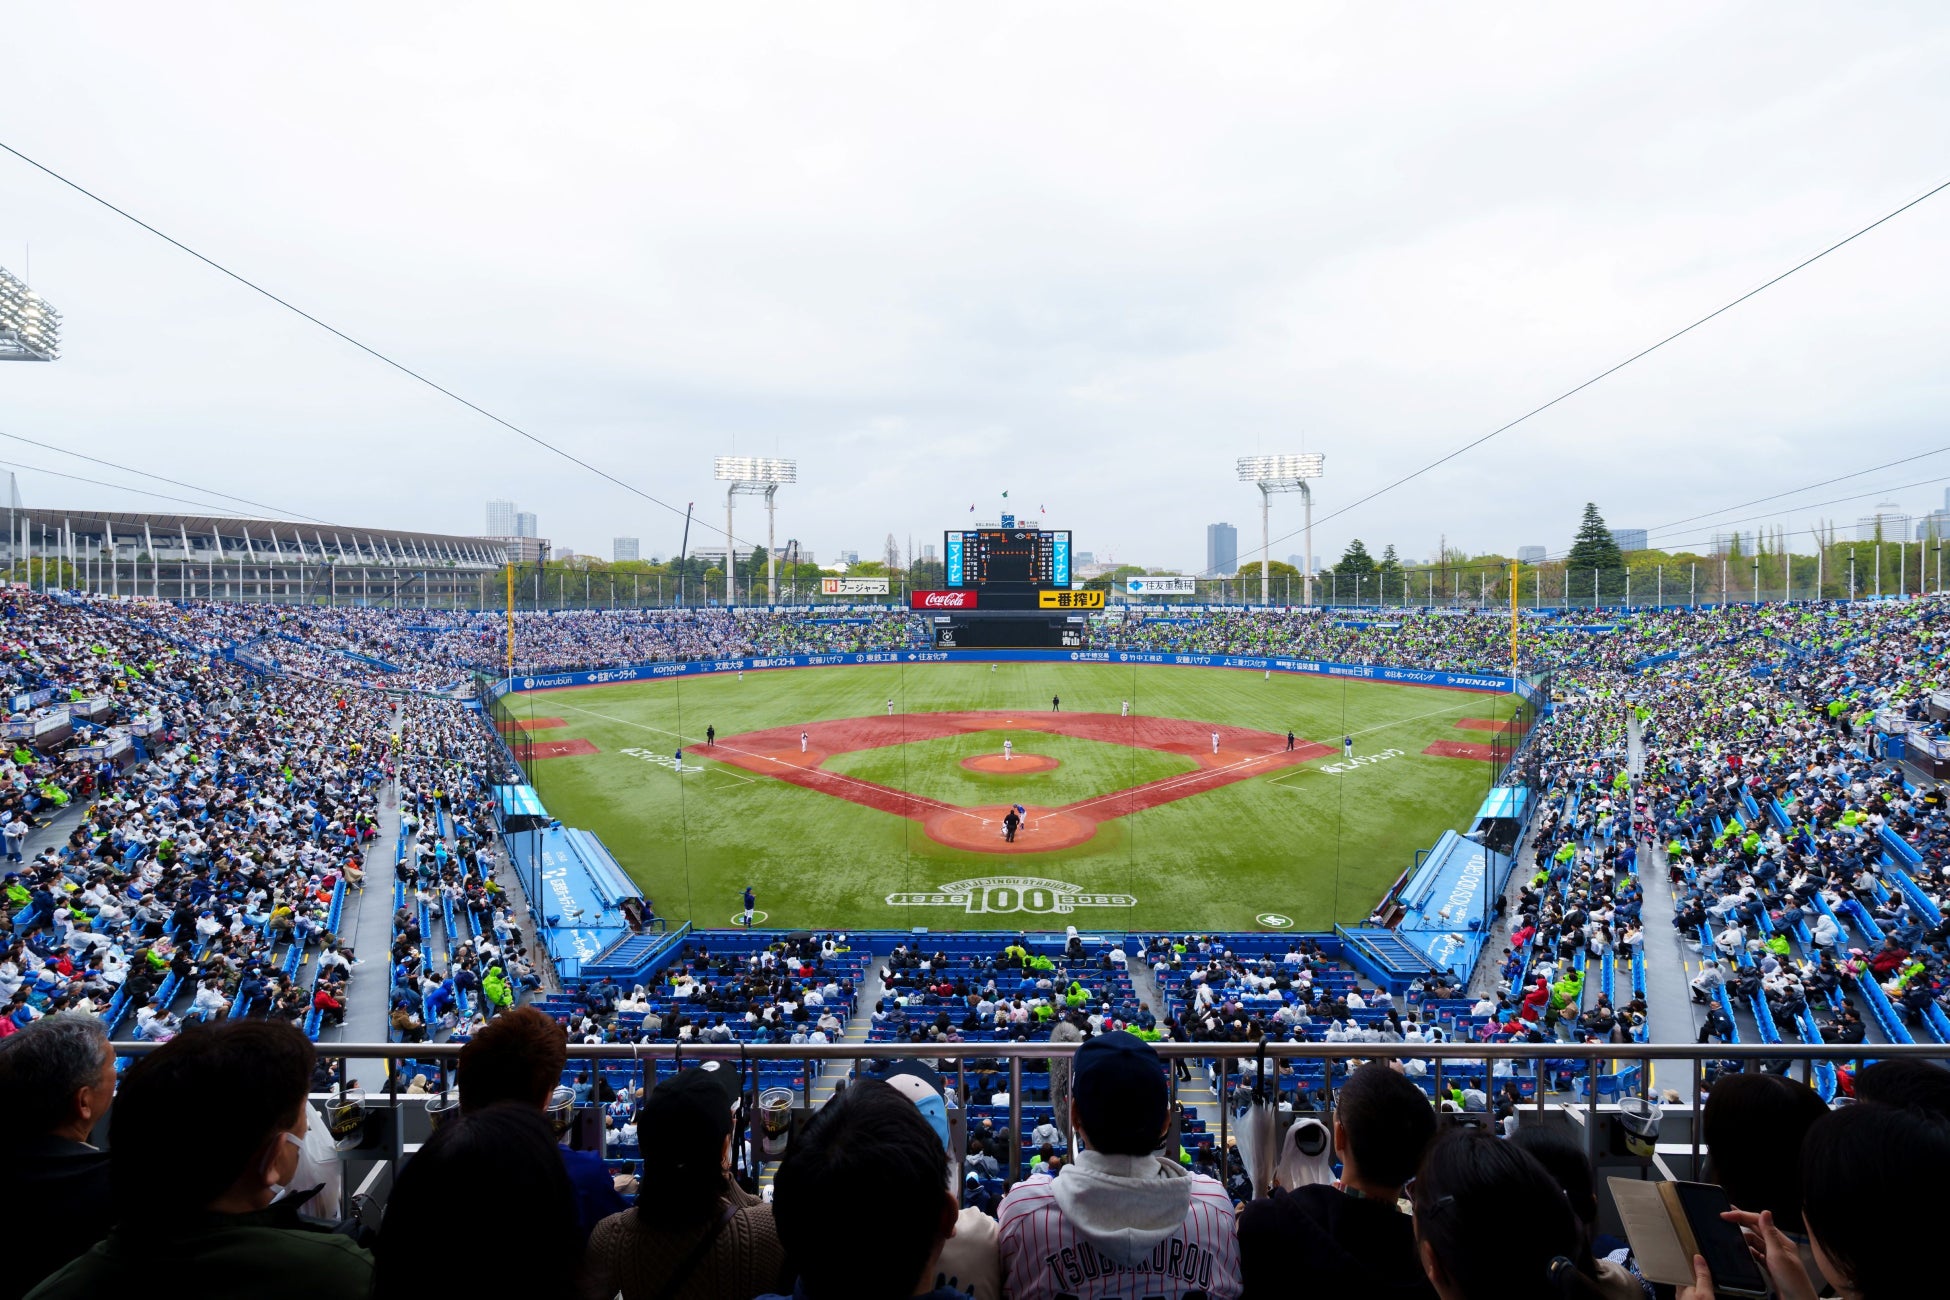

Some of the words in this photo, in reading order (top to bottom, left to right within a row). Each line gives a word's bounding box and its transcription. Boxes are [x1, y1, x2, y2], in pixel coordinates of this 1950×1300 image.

[950, 544, 960, 582] マイナビ
[1056, 544, 1066, 582] マイナビ
[840, 584, 886, 592] フージャース
[1146, 580, 1193, 590] 住友重機械
[926, 592, 966, 606] Coca-Cola
[1044, 592, 1100, 606] 一番搾り
[1062, 636, 1080, 646] 青山
[808, 656, 843, 664] 安藤ハザマ
[866, 654, 898, 662] 東鉄工業
[918, 653, 948, 661] 住友化学
[1176, 656, 1211, 665] 安藤ハザマ
[714, 661, 744, 671] 文教大学
[752, 658, 795, 667] 東進ハイスクール
[1232, 658, 1267, 667] 三菱ガス化学
[598, 670, 637, 682] 住友ベークライト
[1354, 666, 1374, 677] 日新
[1390, 671, 1436, 681] 日本ハウズイング
[536, 678, 572, 687] Marubun
[1456, 678, 1505, 688] DUNLOP
[950, 880, 984, 891] MEIJI
[1022, 880, 1072, 892] STADIUM
[966, 888, 1055, 913] 100
[1046, 1238, 1213, 1290] TSUBUROU
